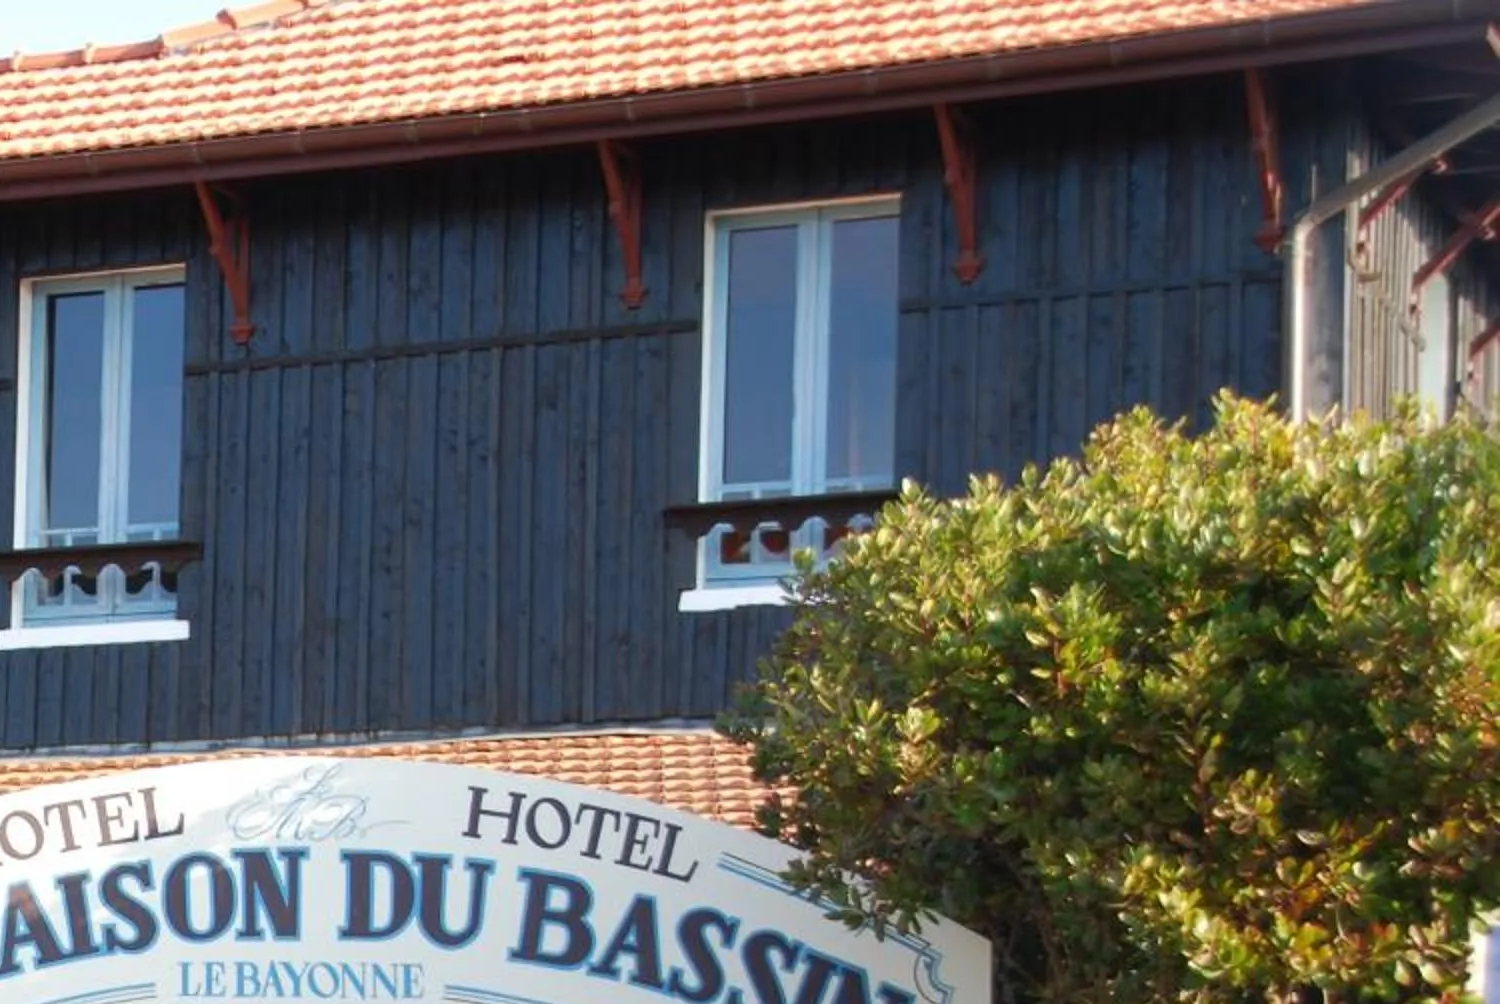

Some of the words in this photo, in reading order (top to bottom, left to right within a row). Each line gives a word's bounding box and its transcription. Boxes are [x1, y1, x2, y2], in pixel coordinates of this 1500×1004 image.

[463, 786, 699, 882] HOTEL
[337, 848, 496, 949] DU
[179, 961, 226, 998] LE
[234, 961, 425, 1000] BAYONNE
